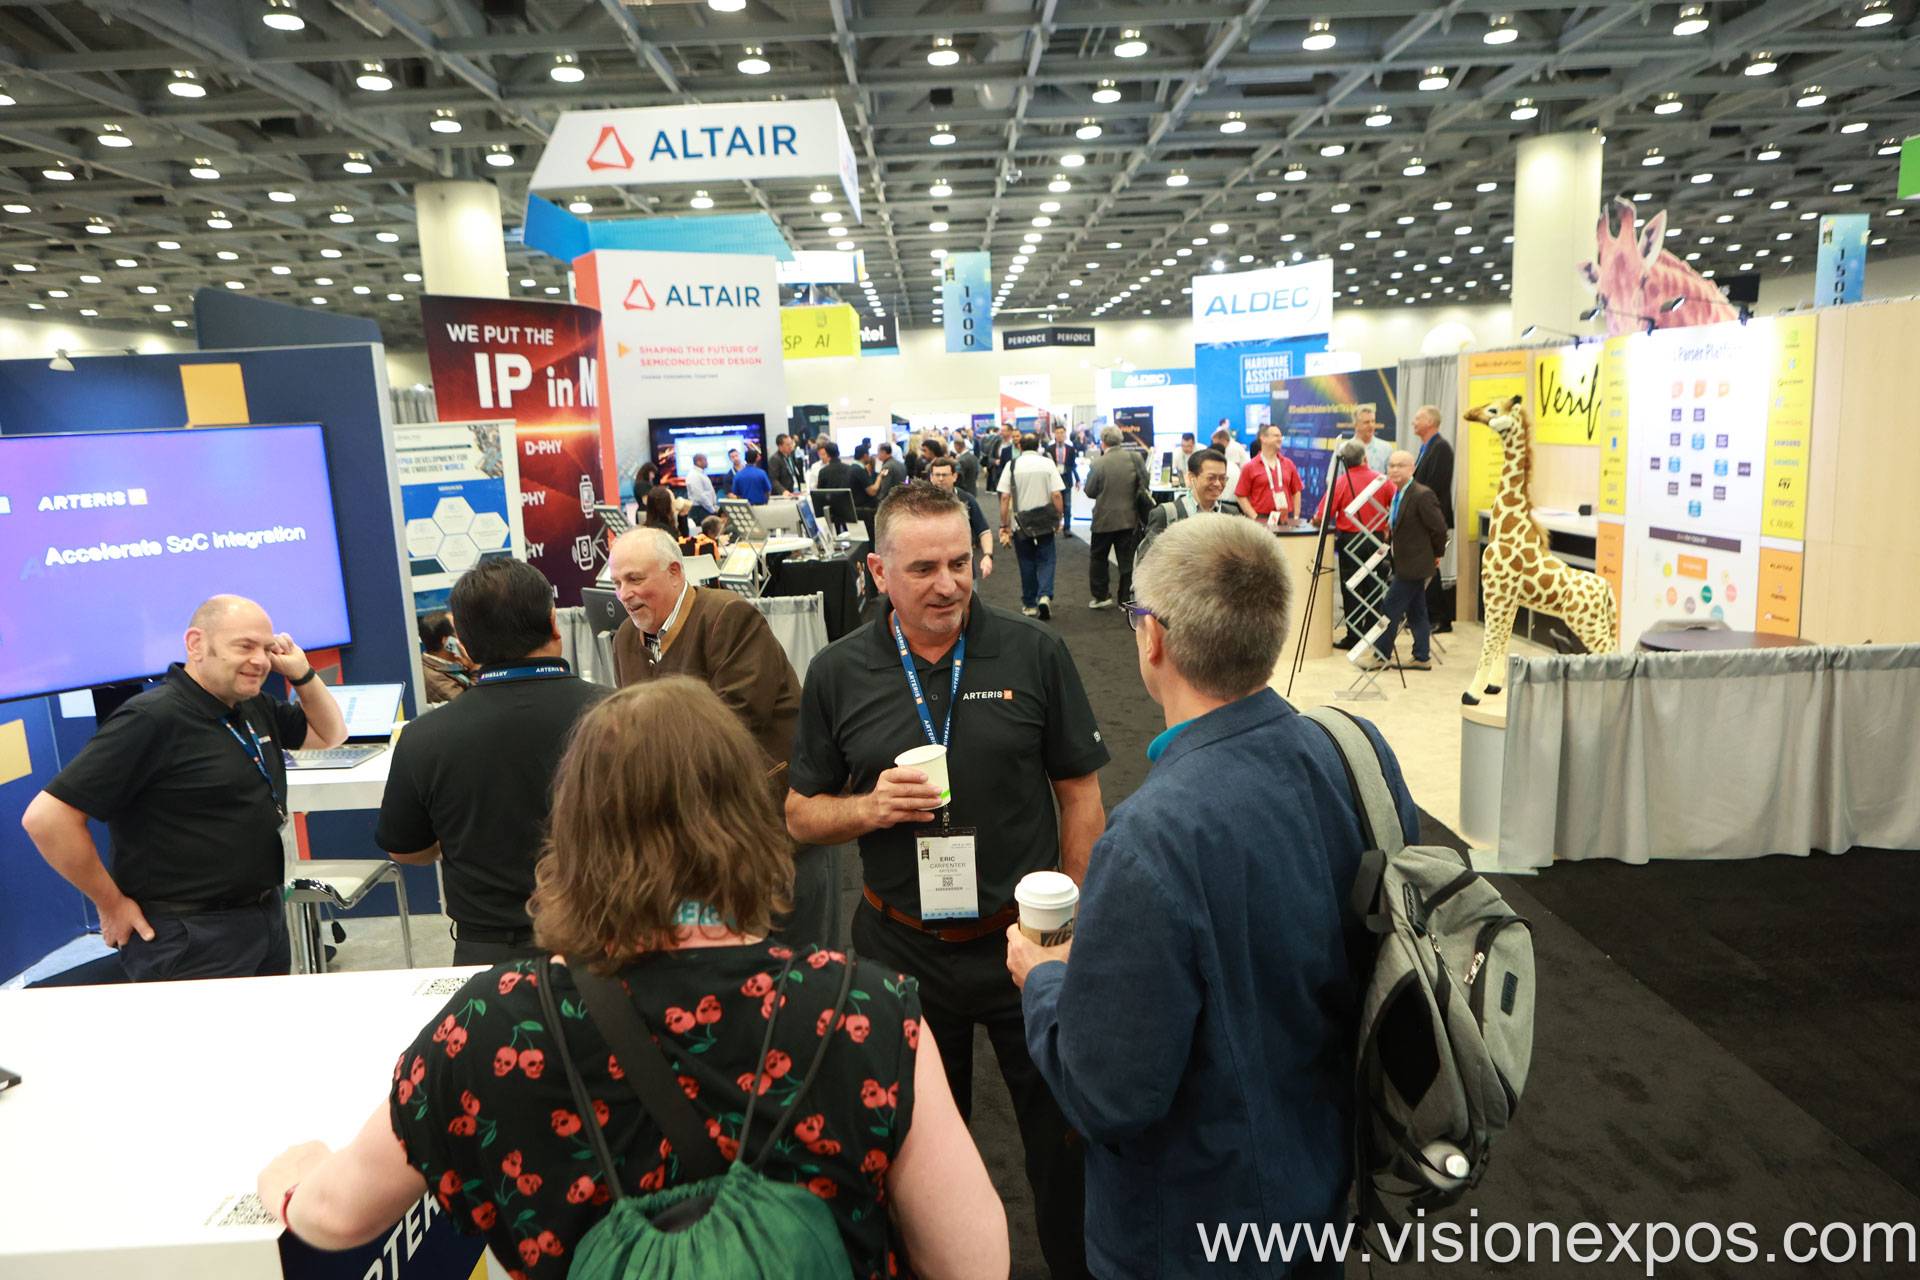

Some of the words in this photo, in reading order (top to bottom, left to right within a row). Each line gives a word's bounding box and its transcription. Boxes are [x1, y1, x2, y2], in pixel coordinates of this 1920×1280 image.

[649, 124, 798, 161] ALTAIR
[666, 285, 761, 308] ALTAIR
[1204, 286, 1309, 317] ALDEC
[962, 285, 975, 347] 1400
[446, 323, 479, 343] WE
[484, 325, 520, 344] PUT
[524, 327, 554, 346] THE
[815, 334, 830, 349] AI
[640, 346, 684, 354] SHAPING
[708, 345, 744, 353] FUTURE
[640, 357, 725, 366] SEMICONDUCTOR
[728, 357, 762, 365] DESIGN
[1245, 355, 1289, 369] HARDWARE
[474, 352, 533, 409] IP
[546, 366, 574, 408] in
[1246, 367, 1289, 382] ASSISTED
[524, 440, 563, 456] D-PHY
[38, 490, 127, 511] ARTERIS
[45, 538, 162, 567] Accelerate
[166, 532, 210, 555] SoC
[907, 670, 921, 698] ARTERIS
[962, 691, 1003, 701] ARTERIS
[923, 719, 938, 745] ARTERI
[929, 862, 967, 870] CARPENTER
